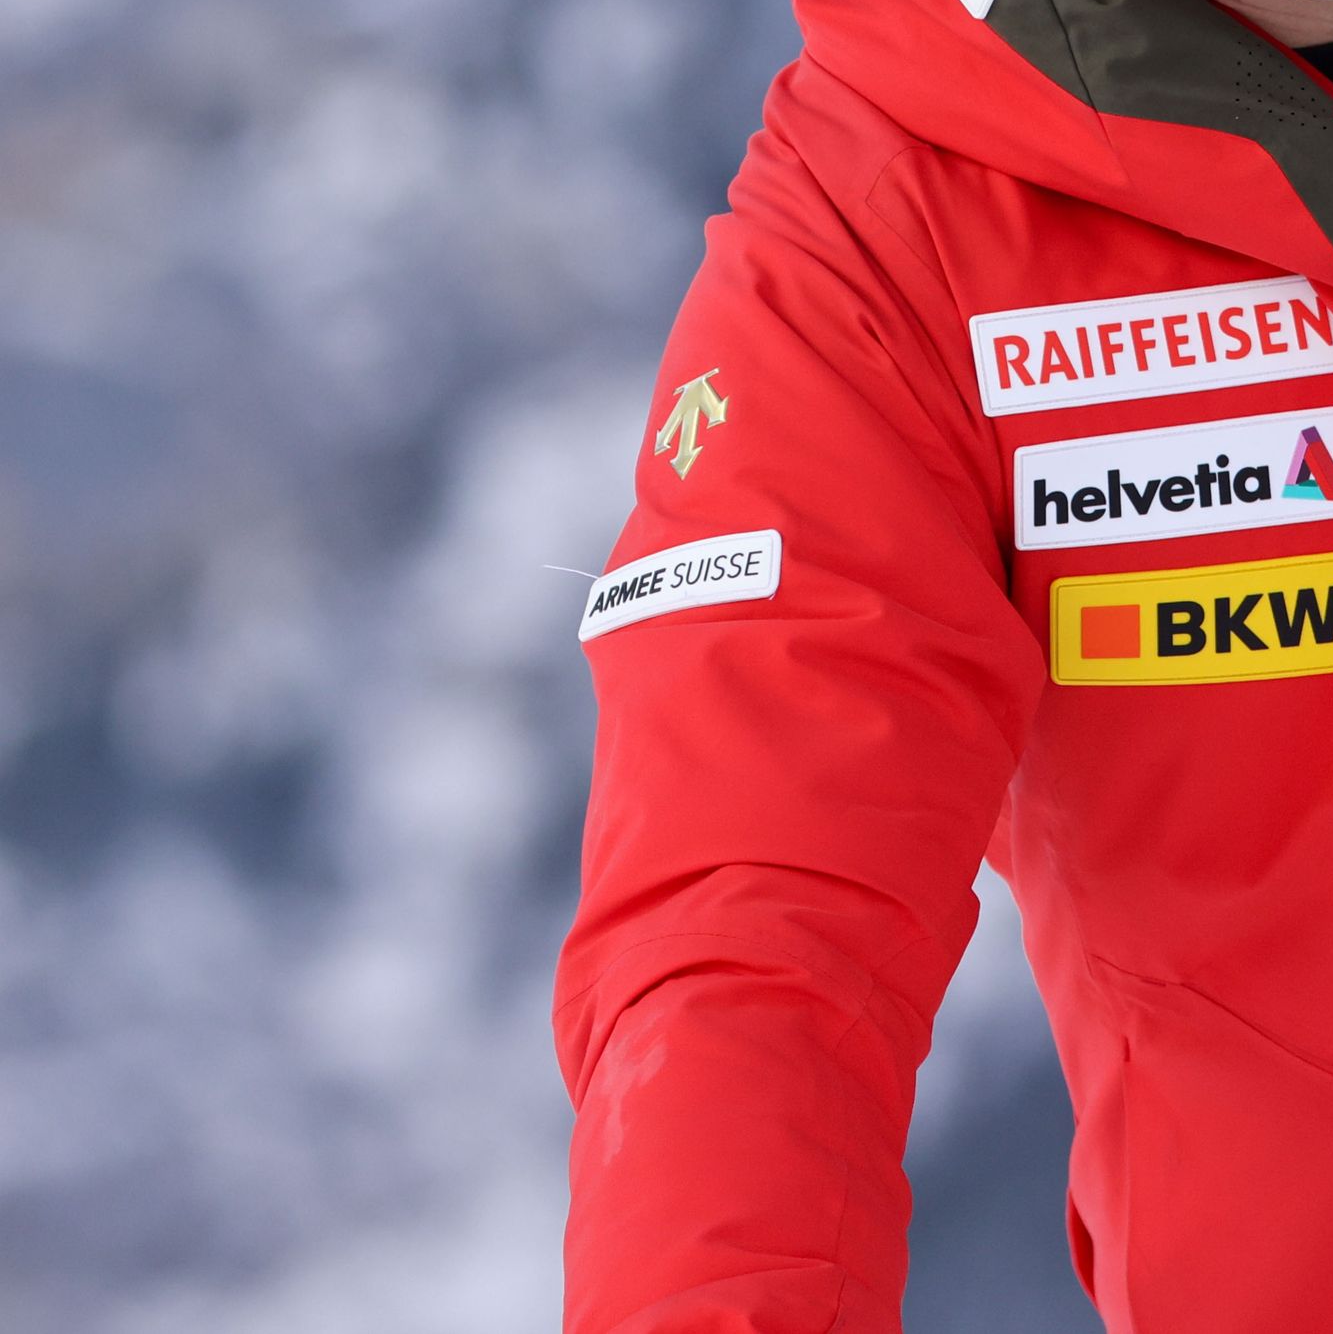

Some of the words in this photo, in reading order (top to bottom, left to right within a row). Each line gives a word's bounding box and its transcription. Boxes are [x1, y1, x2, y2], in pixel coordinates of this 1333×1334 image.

[1032, 453, 1271, 527] helvetia
[589, 567, 667, 618] ARMEE
[670, 550, 763, 589] SUISSE
